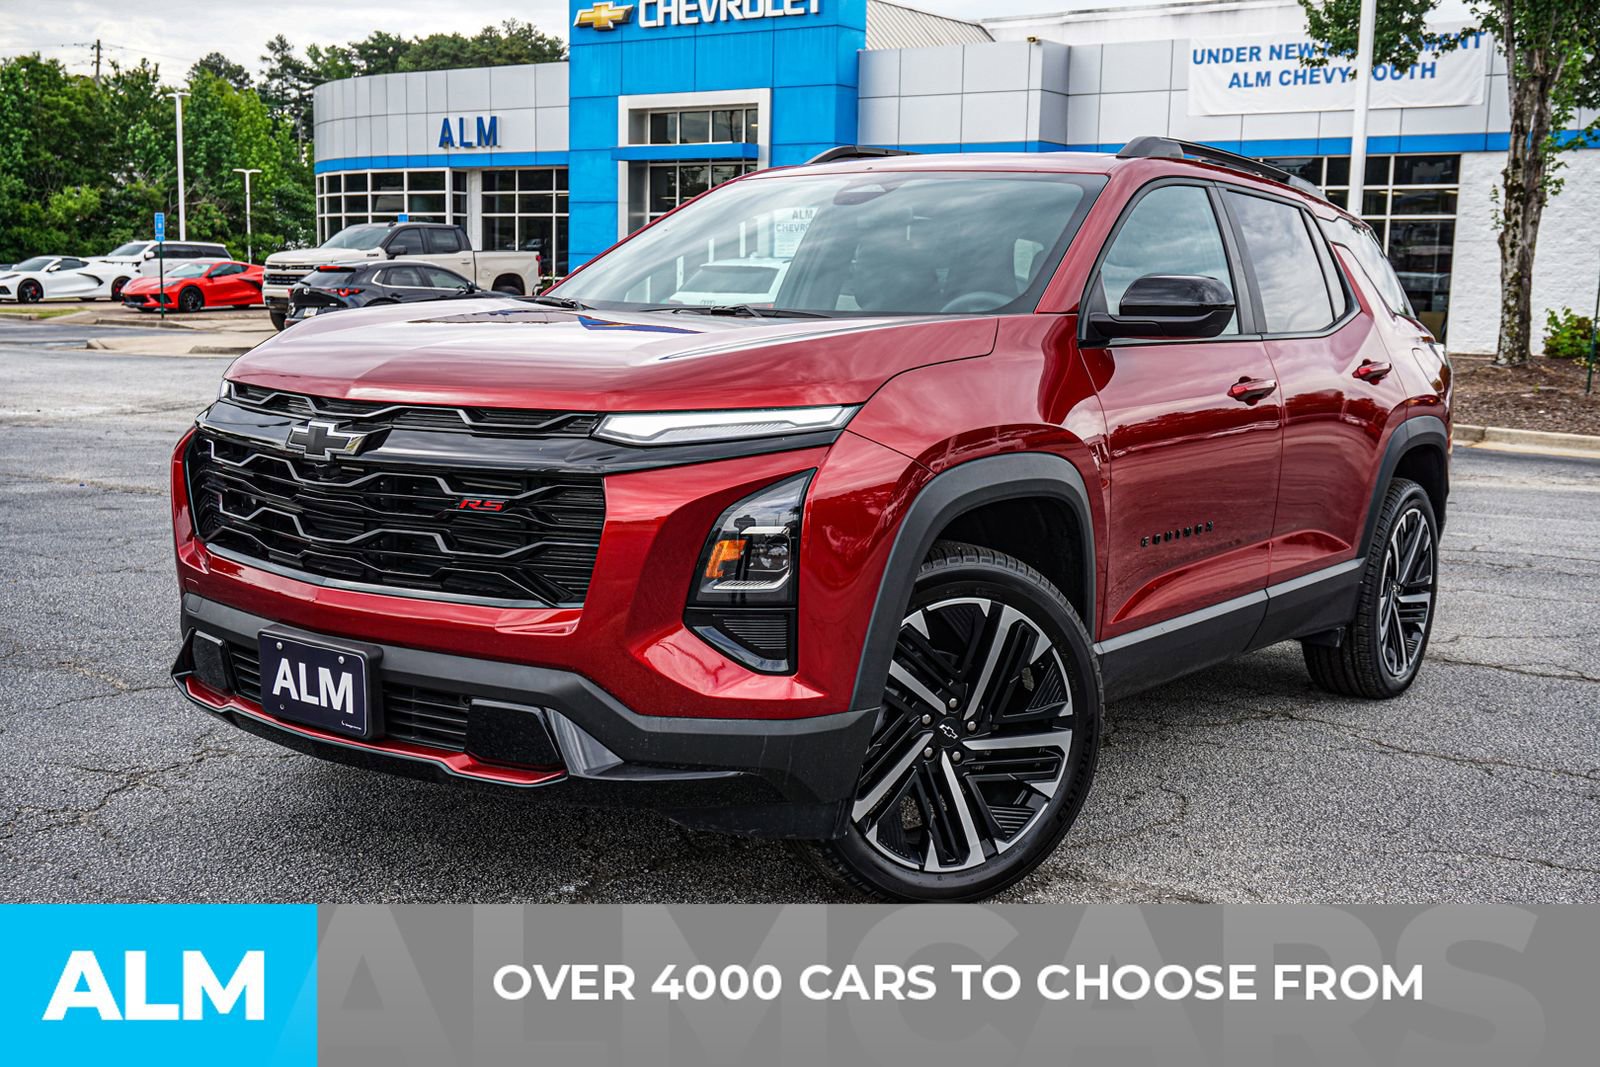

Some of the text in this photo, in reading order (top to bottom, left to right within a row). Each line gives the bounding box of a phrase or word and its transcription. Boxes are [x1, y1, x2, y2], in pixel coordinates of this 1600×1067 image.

[1192, 46, 1262, 65] UNDER
[1269, 42, 1315, 61] NEW
[1228, 62, 1437, 88] ALM CHEVY OUTH
[438, 115, 499, 148] ALM
[792, 209, 813, 220] ALM
[459, 499, 505, 512] RS
[1140, 520, 1214, 548] EQUINOX
[272, 657, 354, 715] ALM
